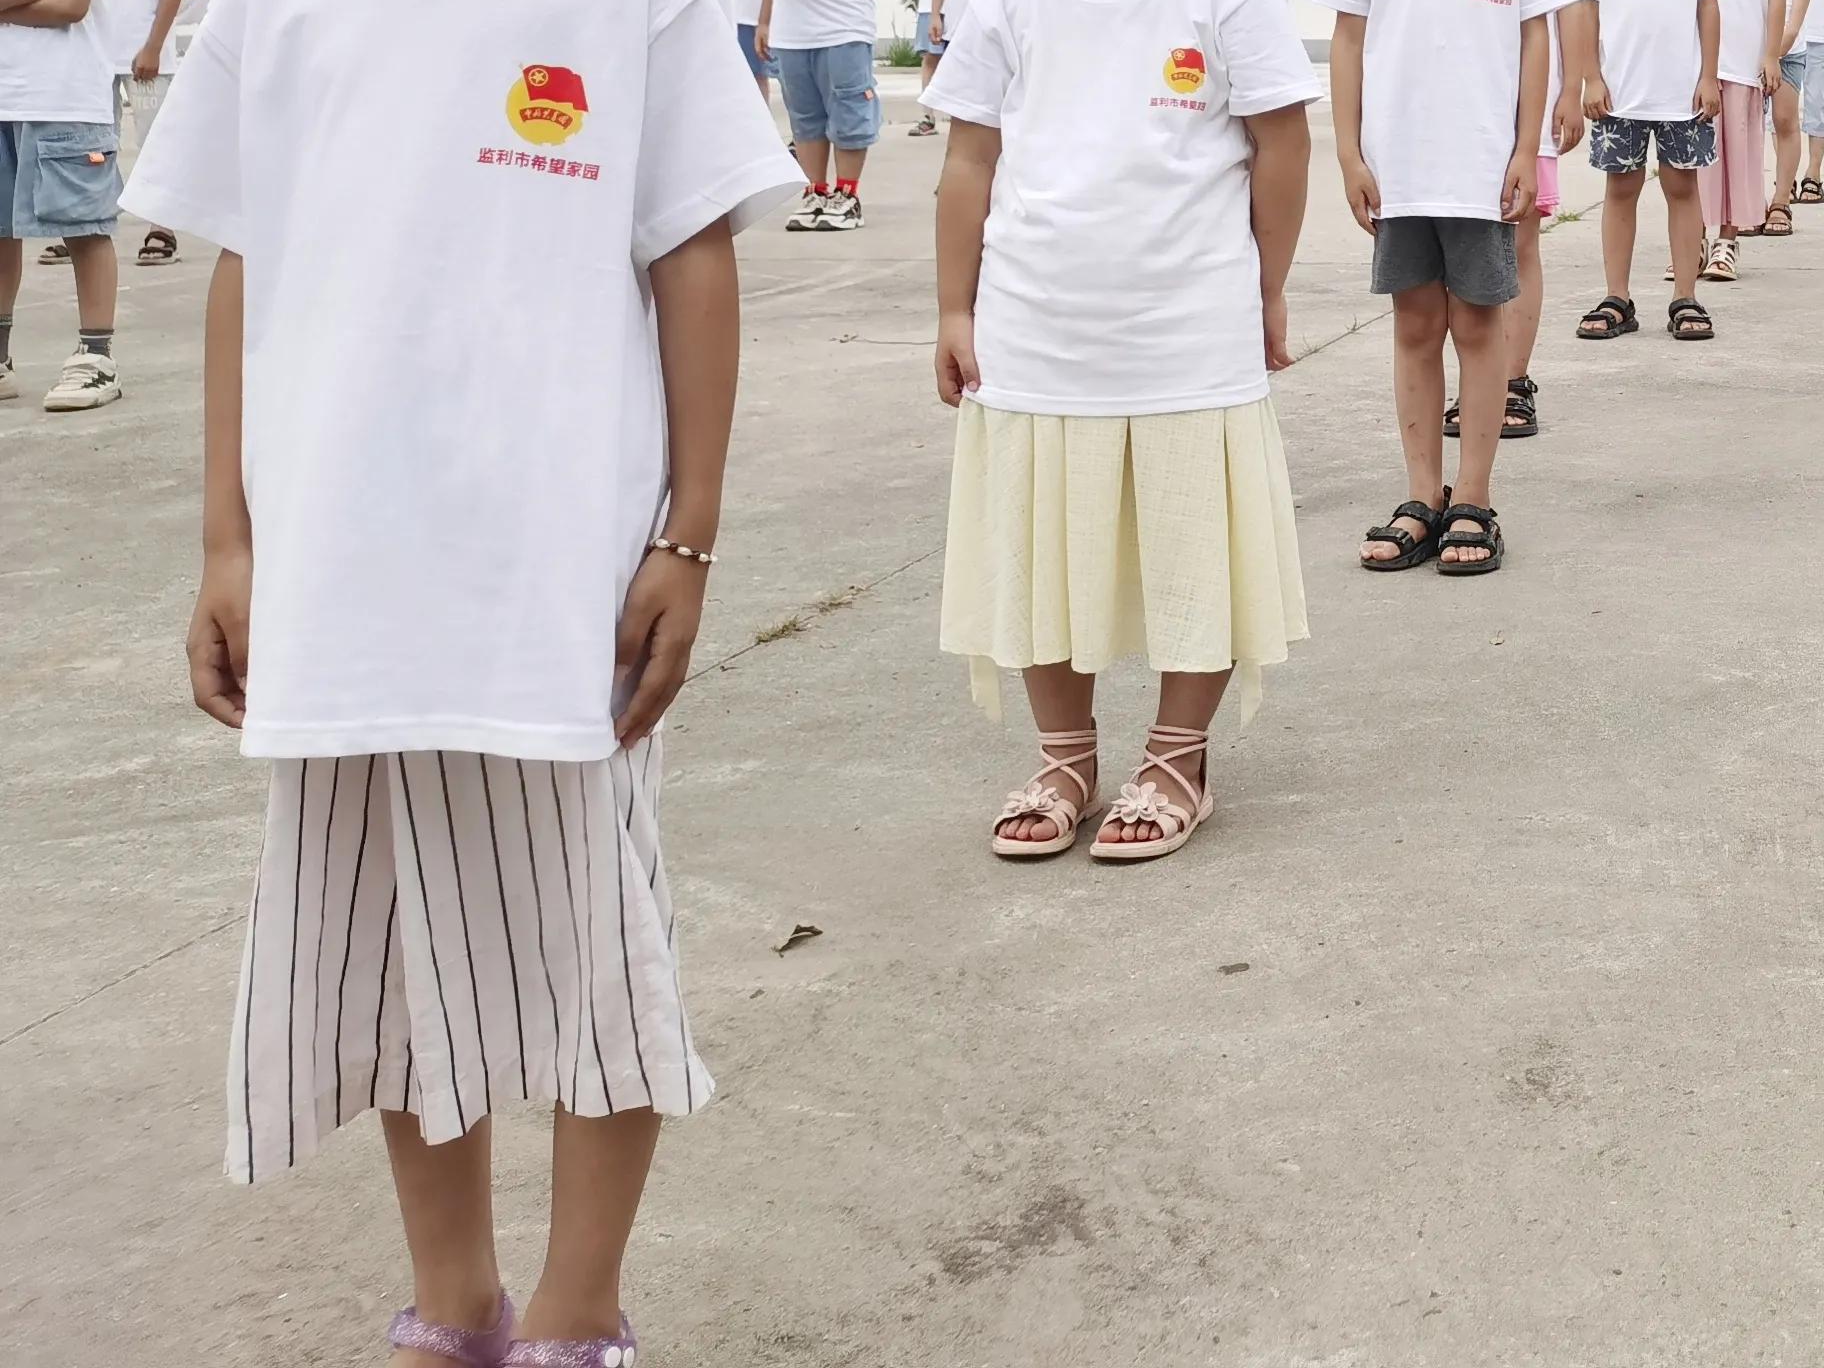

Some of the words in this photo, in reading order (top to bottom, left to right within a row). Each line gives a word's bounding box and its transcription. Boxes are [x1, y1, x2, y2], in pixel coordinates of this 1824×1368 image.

[477, 147, 601, 181] 监利市希望家园
